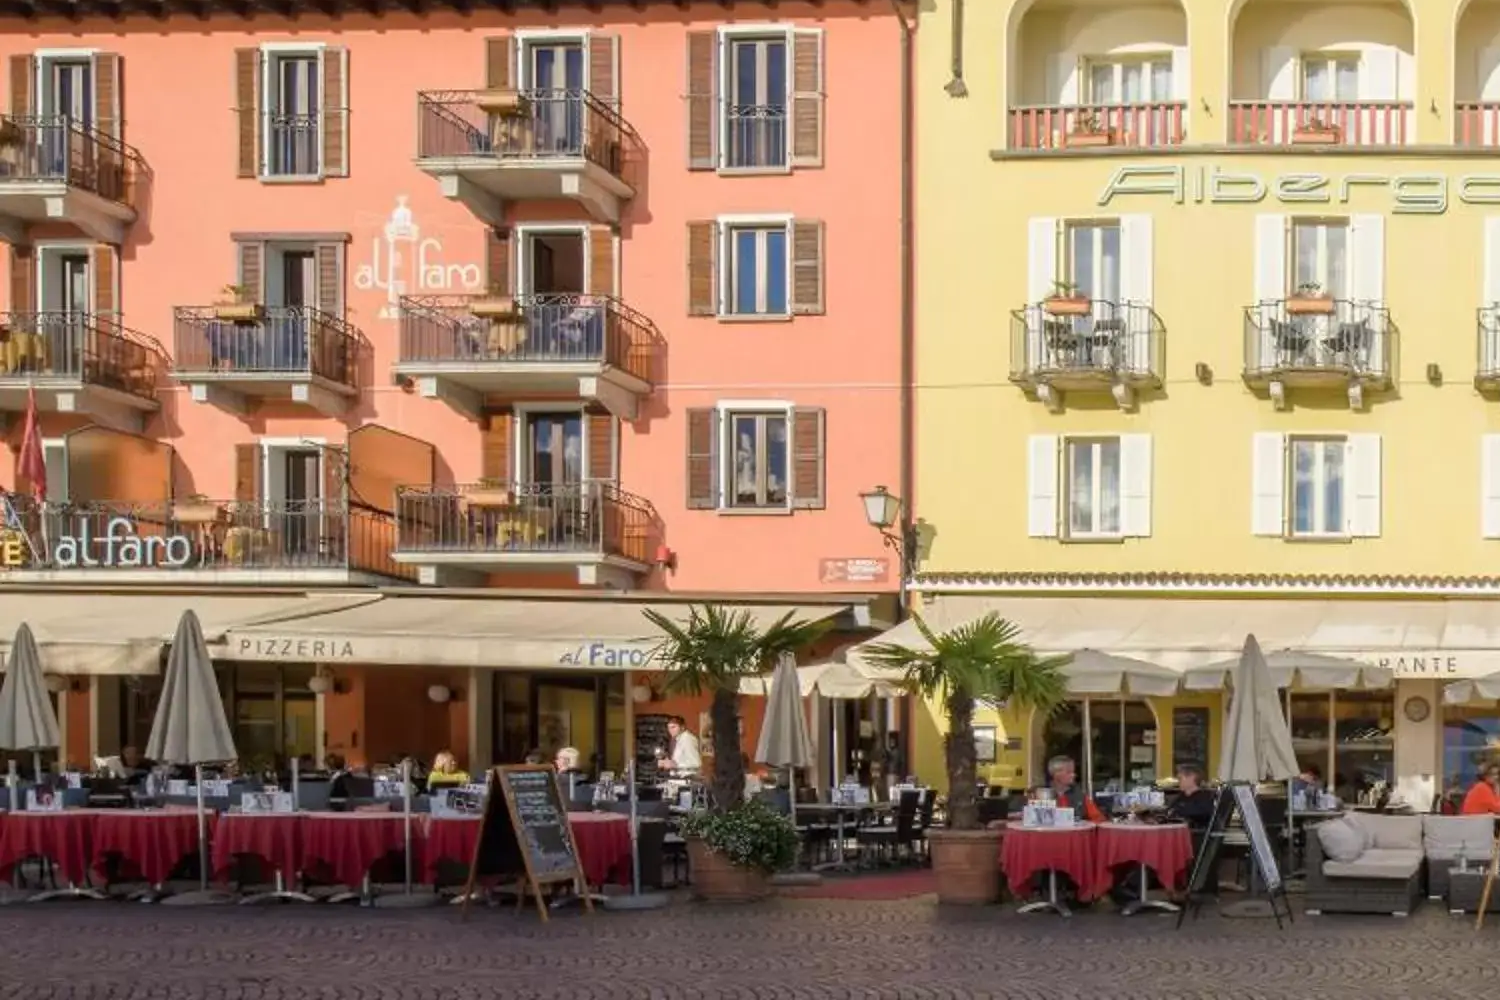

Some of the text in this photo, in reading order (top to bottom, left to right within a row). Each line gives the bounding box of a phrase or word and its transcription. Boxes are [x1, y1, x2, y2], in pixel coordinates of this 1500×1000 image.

[419, 237, 480, 289] faro
[240, 639, 354, 657] PIZZERIA
[588, 643, 643, 667] Faro
